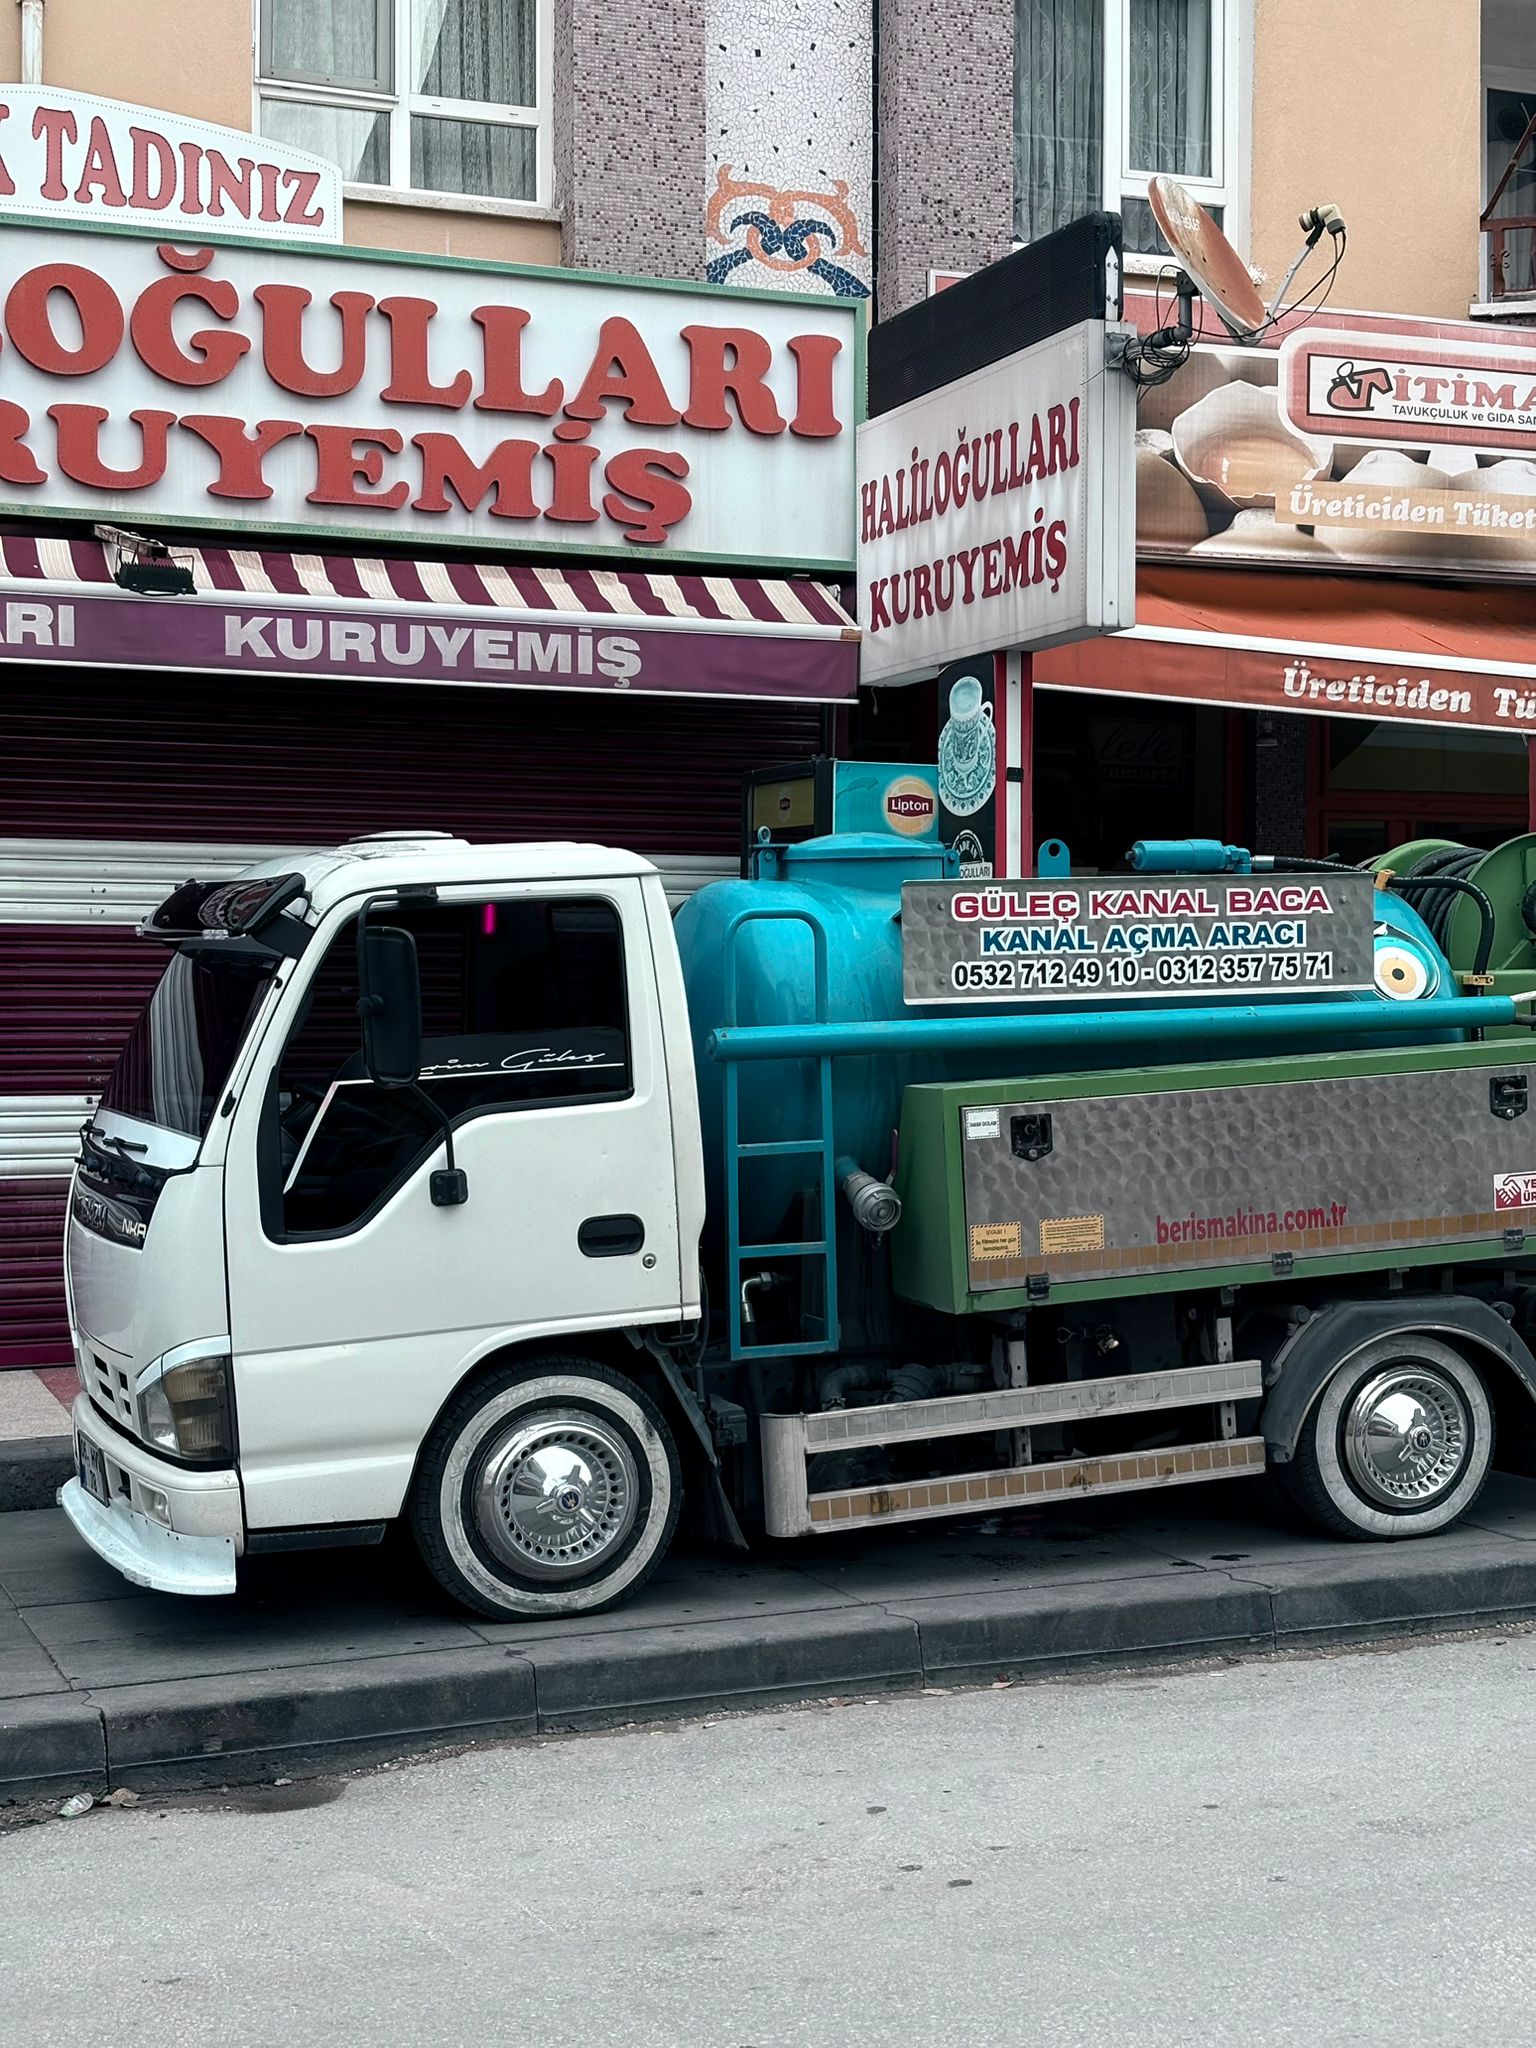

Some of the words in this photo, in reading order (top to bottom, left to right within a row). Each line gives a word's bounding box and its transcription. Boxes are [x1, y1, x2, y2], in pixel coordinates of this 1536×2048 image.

[32, 106, 324, 227] TADINIZ
[0, 245, 843, 438] OĞULLARI
[1392, 404, 1469, 420] TAVUKÇULUK
[1471, 412, 1484, 421] ve
[1487, 412, 1515, 424] GIDA
[861, 396, 1081, 544] HALİLOĞULLARI
[1289, 484, 1445, 523] Üreticiden
[870, 507, 1067, 633] KURUYEMİŞ
[0, 602, 76, 647] RI
[225, 615, 643, 689] KURUYEMİŞ
[1283, 660, 1472, 713] Üreticiden
[891, 799, 930, 812] Lipton
[954, 890, 1078, 923] GÜLEÇ
[1091, 890, 1216, 916] KANAL
[1228, 889, 1329, 913] BACA
[982, 927, 1095, 952] KANAL
[1105, 924, 1199, 955] AÇMA
[1209, 923, 1304, 947] ARACI
[954, 962, 1013, 987] 0532
[1020, 961, 1064, 985] 712
[1071, 960, 1101, 984] 49
[1109, 959, 1137, 983] 10
[1158, 956, 1215, 982] 0312
[1221, 956, 1264, 981] 357
[1272, 955, 1299, 979] 75
[1306, 954, 1331, 977] 71
[1155, 1201, 1348, 1245] berismakina.com.tr
